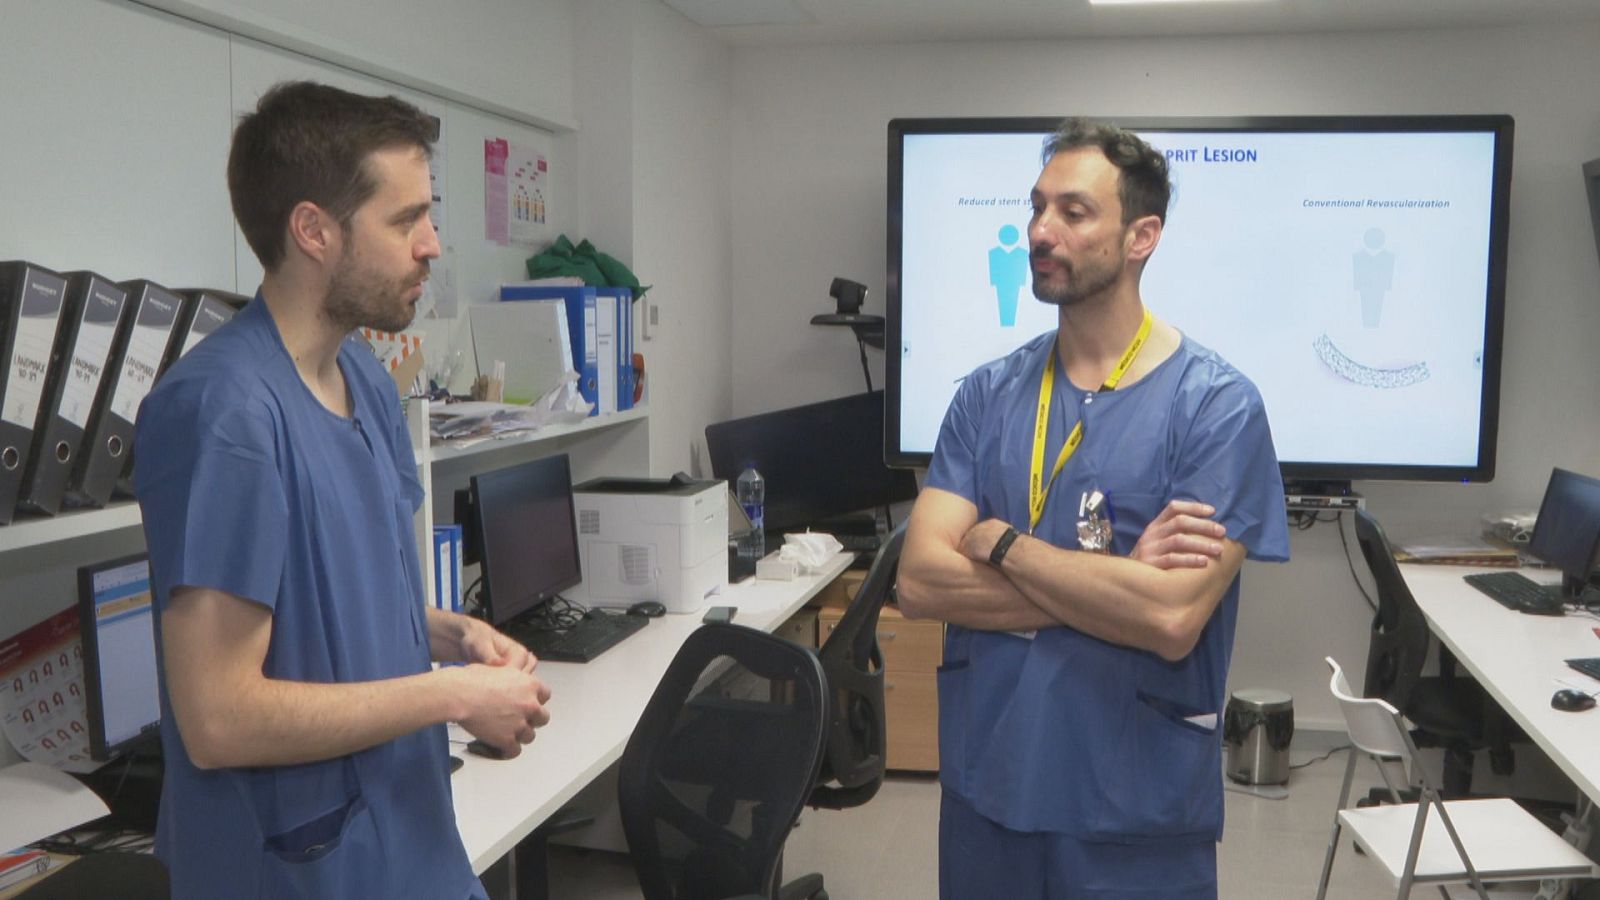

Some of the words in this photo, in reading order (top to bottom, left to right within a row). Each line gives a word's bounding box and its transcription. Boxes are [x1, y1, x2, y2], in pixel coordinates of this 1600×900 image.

[1165, 149, 1198, 162] PRIT
[1204, 146, 1257, 162] LESION
[958, 197, 996, 206] Reduced
[999, 197, 1021, 206] stent
[1302, 199, 1365, 208] Conventional
[1366, 199, 1450, 208] Revascularization
